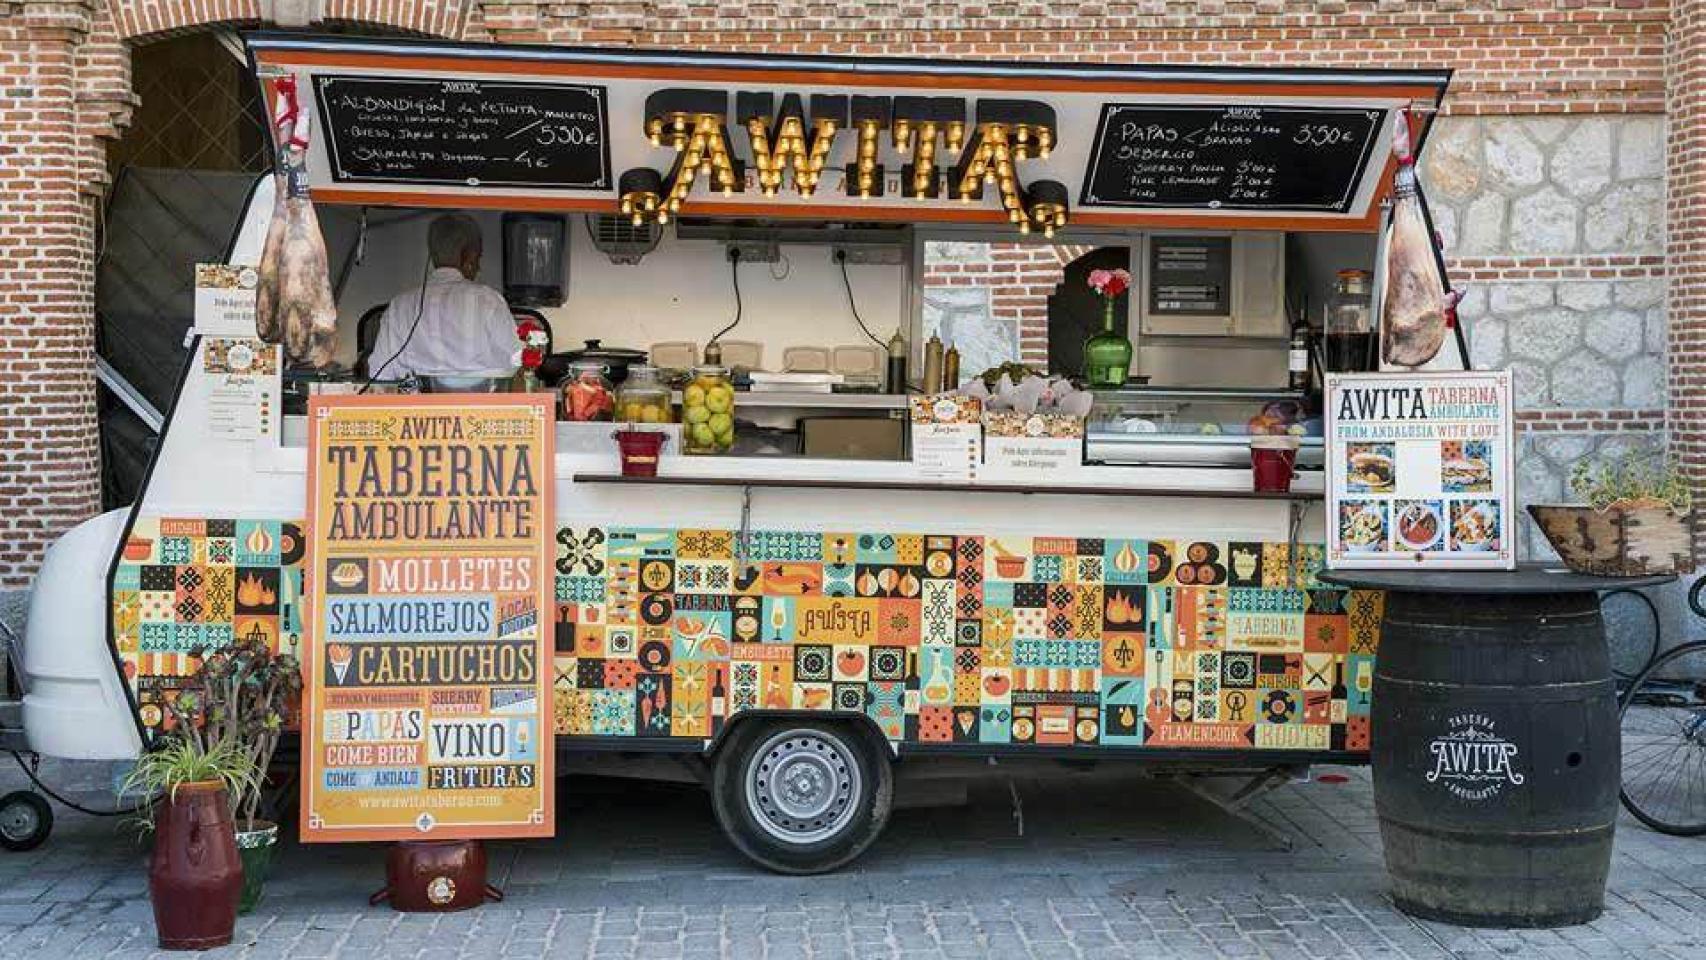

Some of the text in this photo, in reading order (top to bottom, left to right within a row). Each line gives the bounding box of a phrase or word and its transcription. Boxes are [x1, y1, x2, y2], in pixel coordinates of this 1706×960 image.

[618, 88, 1068, 237] AWITA
[1337, 386, 1498, 420] AWITA TABERNA
[400, 416, 464, 440] AWITA
[1337, 425, 1367, 438] FROM
[1437, 424, 1467, 438] WITH
[1471, 424, 1500, 437] LOVE
[328, 444, 538, 498] TABERNA
[327, 500, 531, 541] AMBULANTE
[377, 556, 532, 593] MOLLETES
[331, 601, 490, 634] SALMOREJOS
[358, 644, 535, 684] CARTUCHOS
[431, 689, 482, 704] SHERRY
[346, 709, 421, 740] PAPAS
[432, 722, 506, 758] VINO
[326, 744, 417, 766] COME BIEN
[1425, 740, 1525, 785] AWITA
[326, 771, 357, 787] COME
[430, 765, 531, 789] FRITURAS
